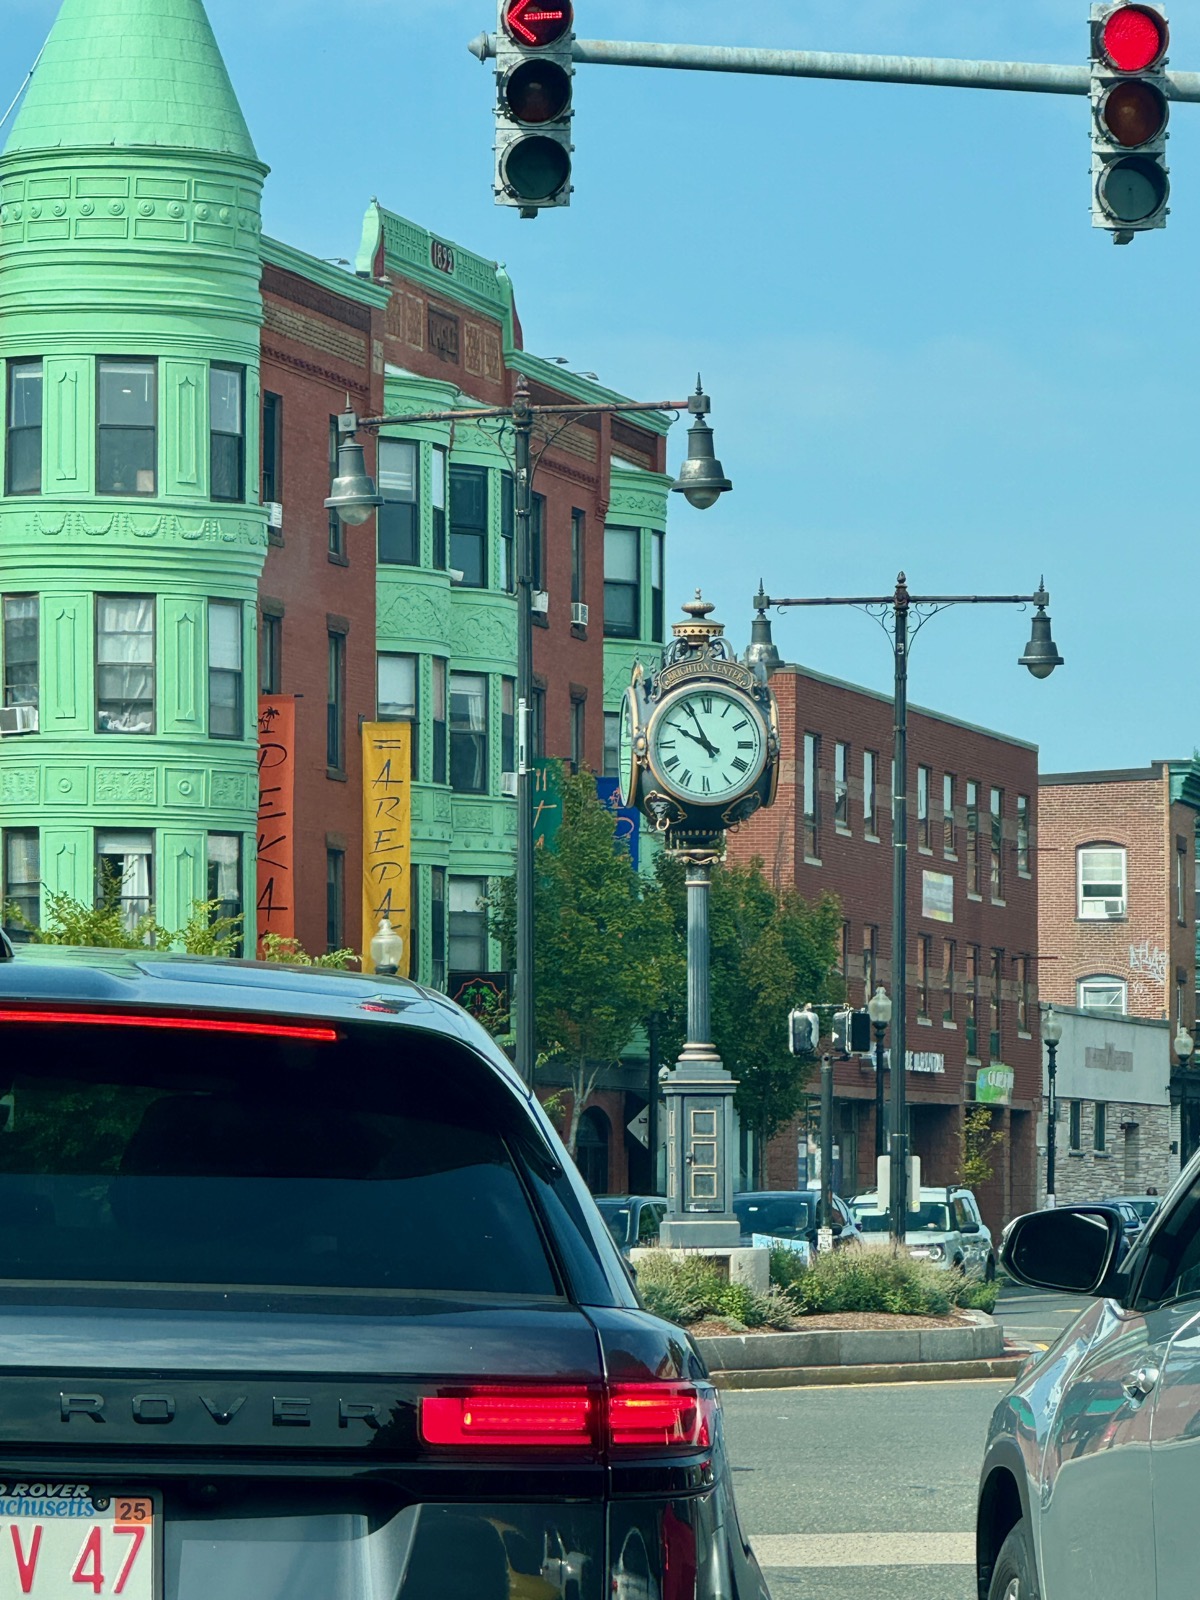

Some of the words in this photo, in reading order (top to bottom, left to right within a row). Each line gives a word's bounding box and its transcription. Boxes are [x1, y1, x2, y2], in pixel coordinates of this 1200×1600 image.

[434, 241, 453, 273] 1892
[666, 662, 709, 681] BRIGHTON
[712, 663, 744, 681] CENTER
[257, 743, 288, 922] PEKA
[370, 758, 406, 931] AREPA
[60, 1393, 381, 1429] ROVER
[12, 1483, 90, 1497] ROVER
[120, 1502, 146, 1520] 25
[10, 1524, 43, 1593] V
[72, 1525, 145, 1594] 47
